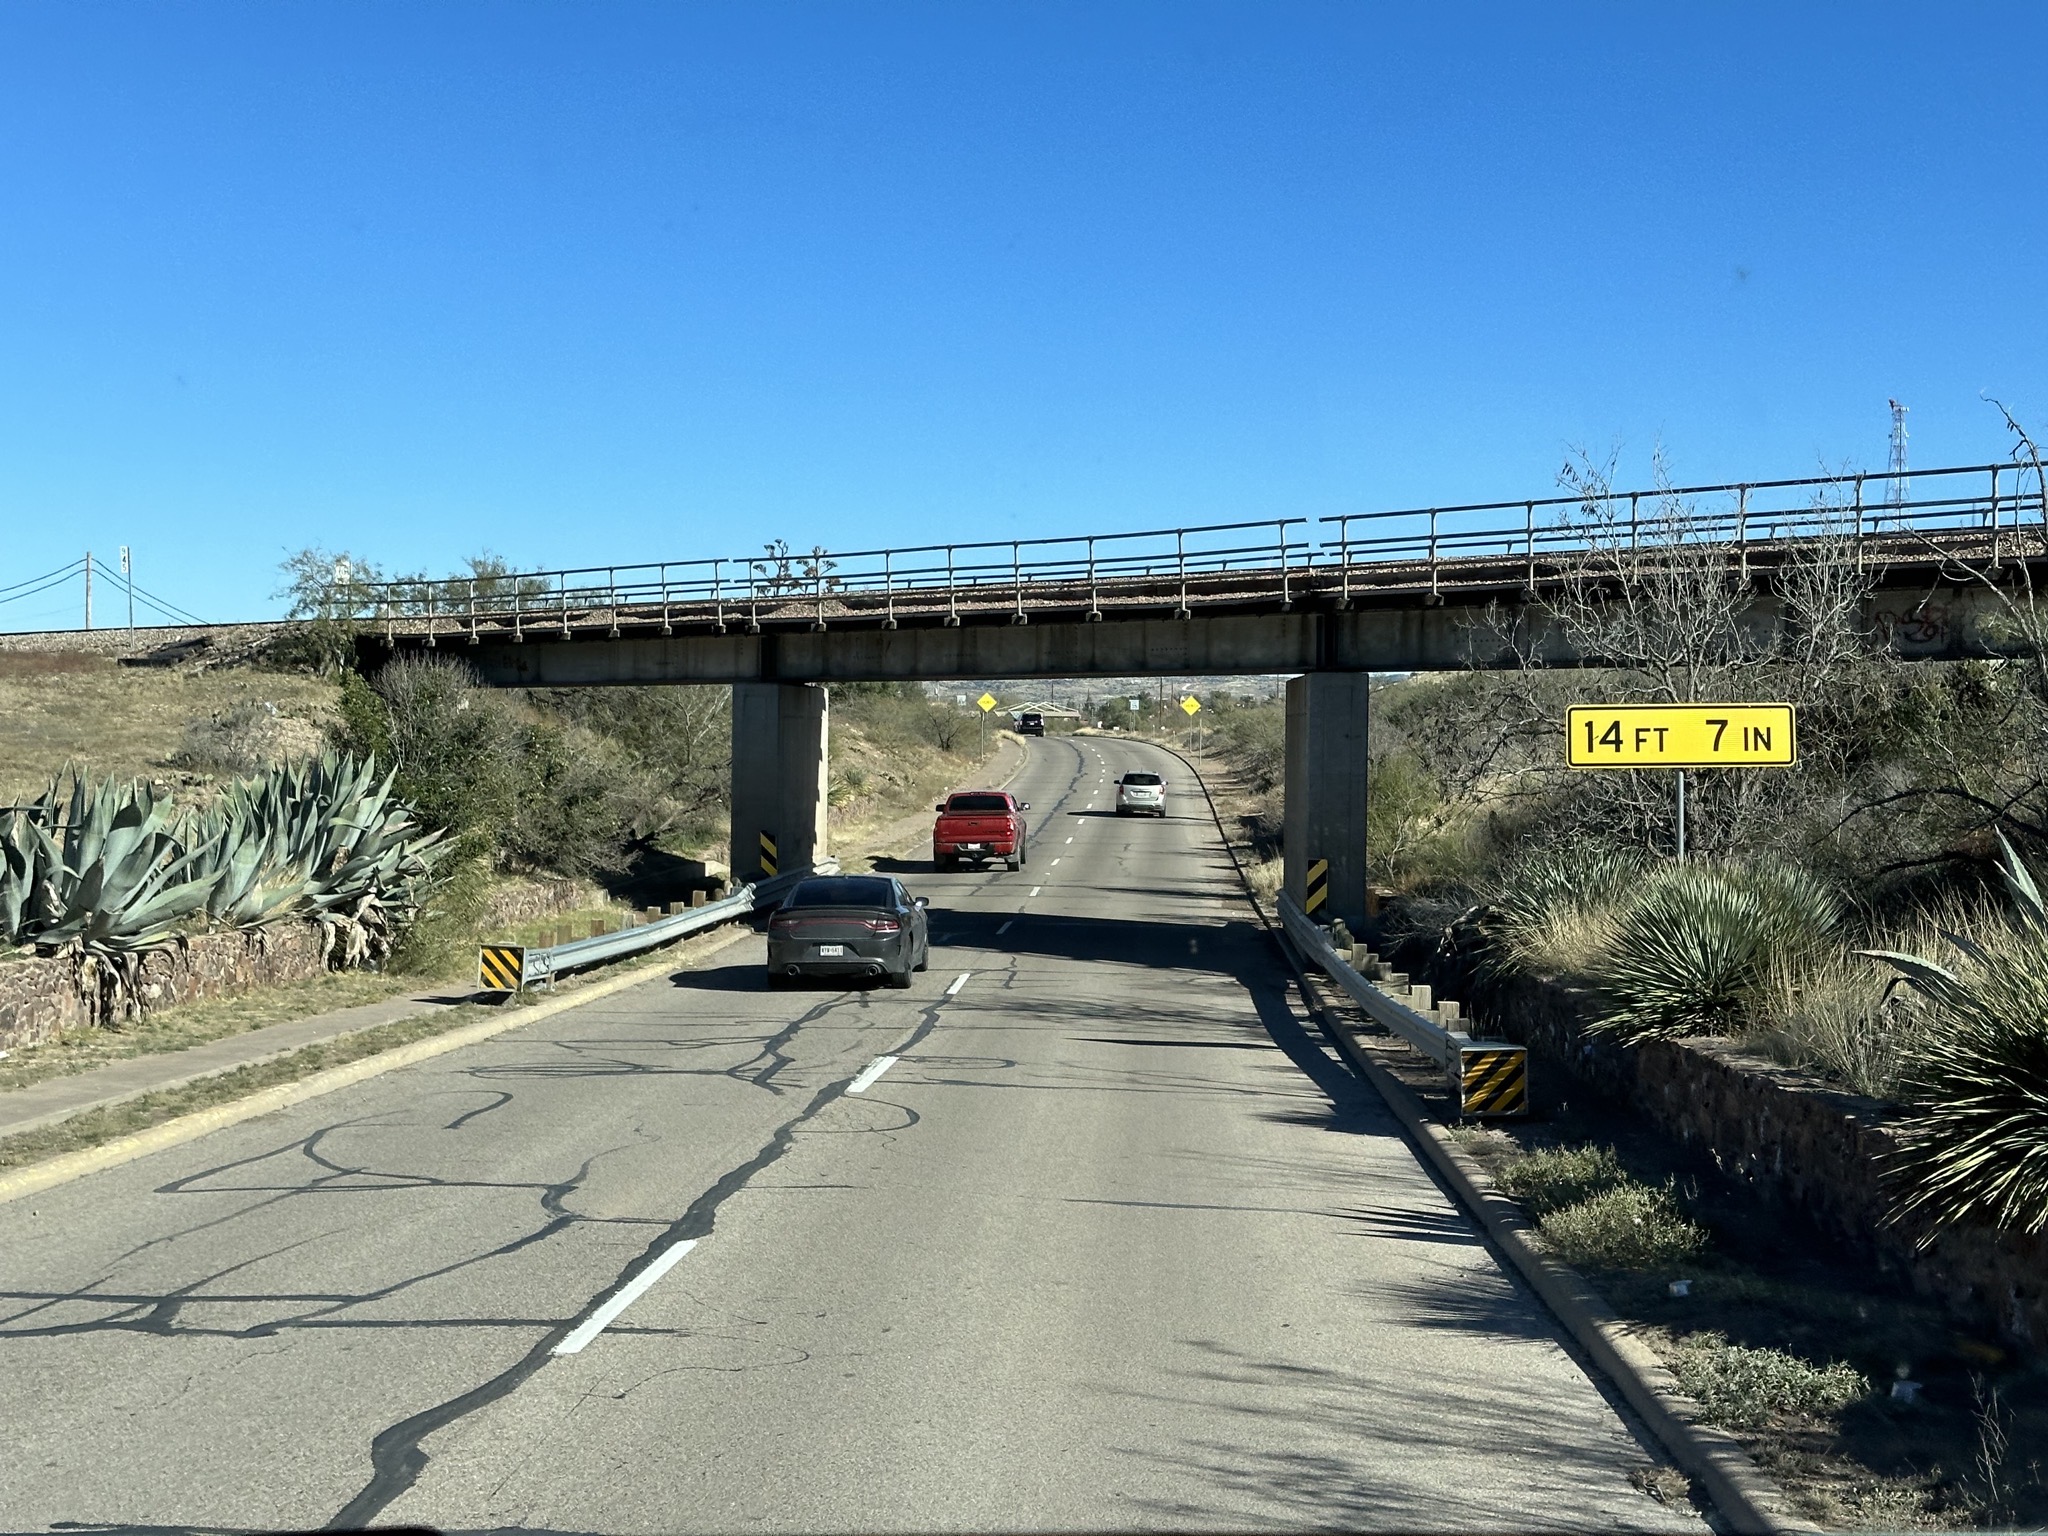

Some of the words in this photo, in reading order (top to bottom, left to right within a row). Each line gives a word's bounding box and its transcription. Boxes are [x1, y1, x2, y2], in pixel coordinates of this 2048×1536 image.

[1585, 720, 1623, 753] 14
[1635, 728, 1669, 752] FT
[1706, 719, 1729, 751] 7
[1743, 727, 1772, 751] IN
